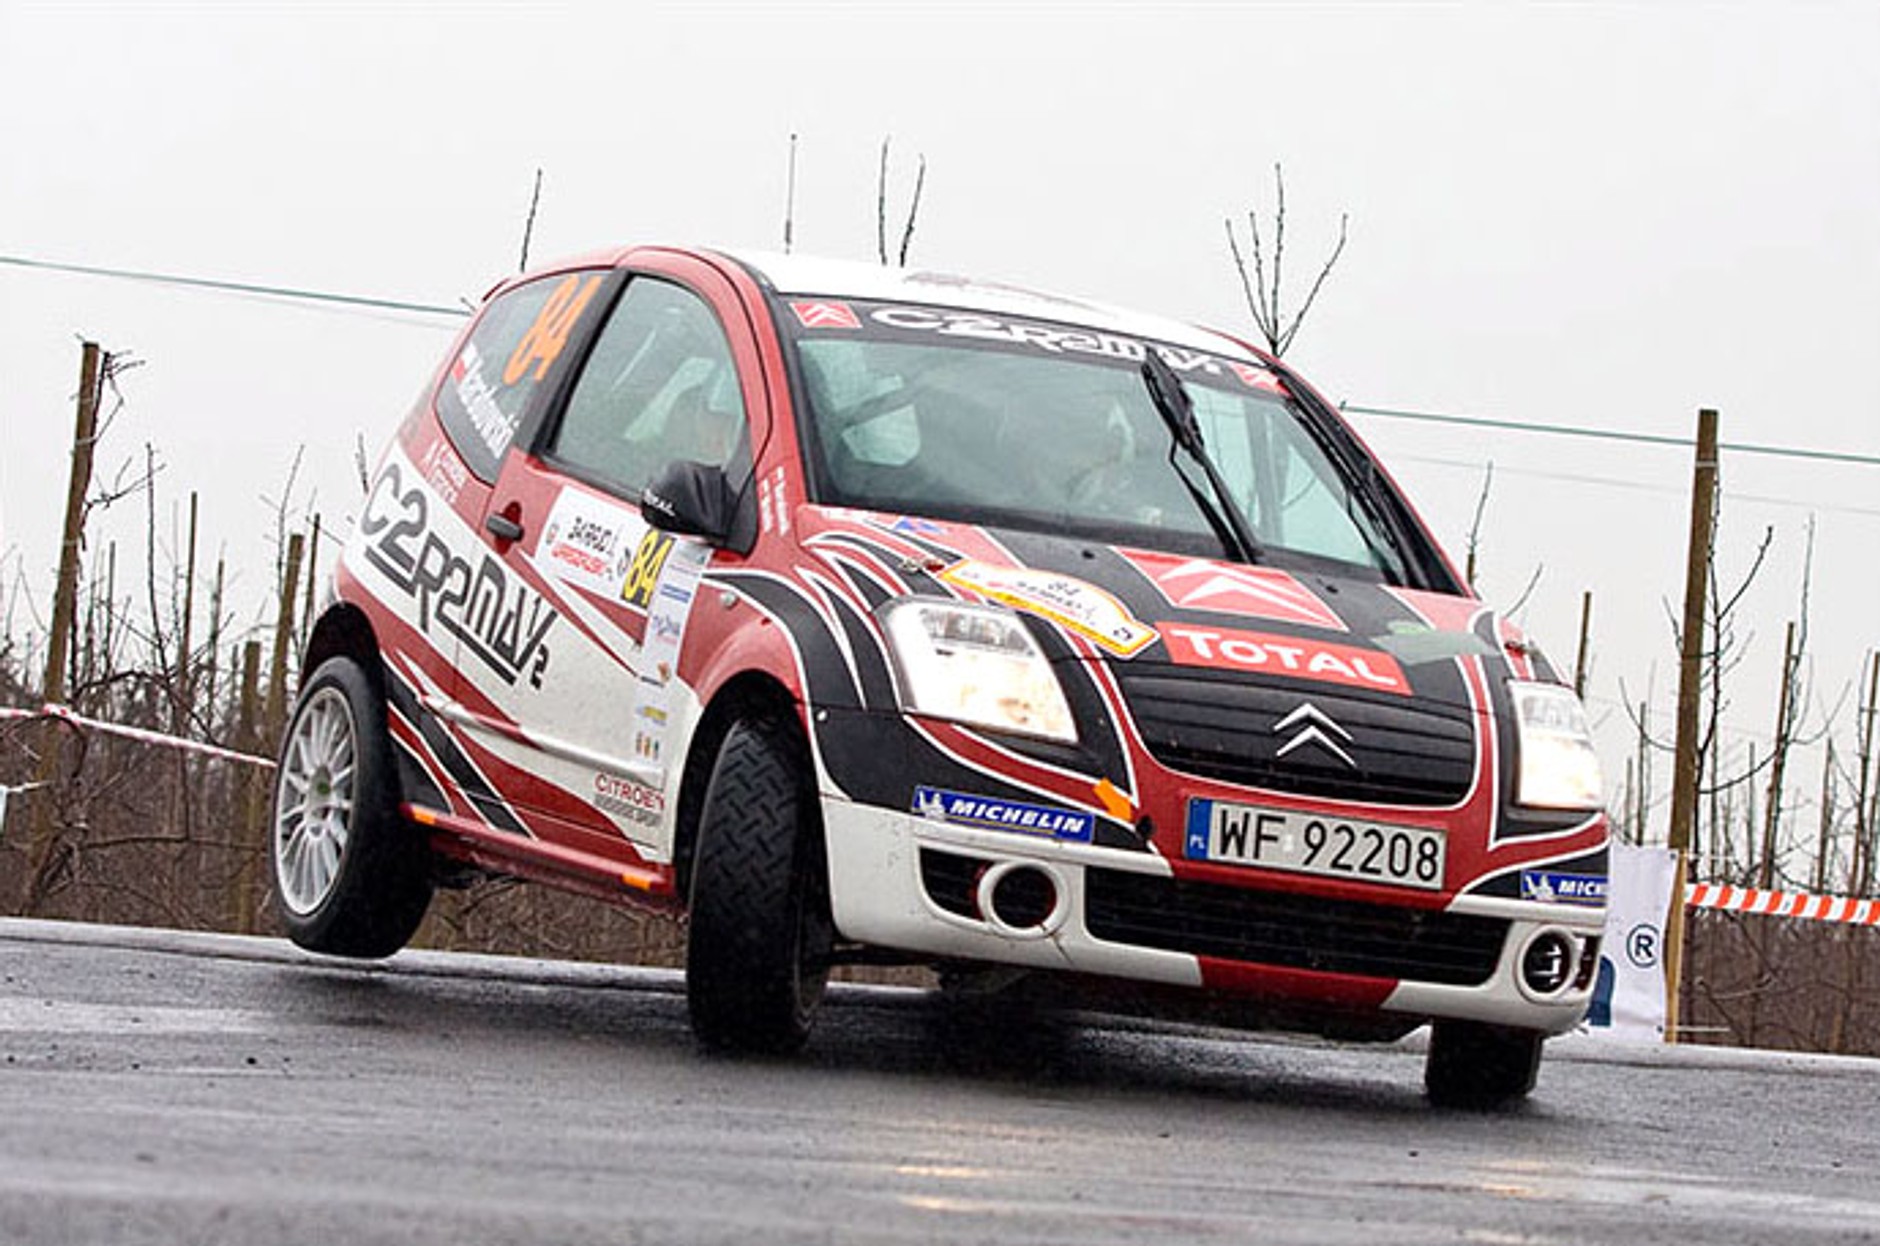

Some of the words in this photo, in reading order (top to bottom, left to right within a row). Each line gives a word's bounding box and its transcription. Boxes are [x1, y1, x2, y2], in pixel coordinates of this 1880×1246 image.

[503, 275, 601, 384] 84
[624, 529, 673, 605] 84
[1170, 629, 1398, 686] TOTAL
[951, 799, 1086, 834] MICHELIN
[1219, 809, 1286, 860] WF
[1303, 820, 1438, 882] 92208
